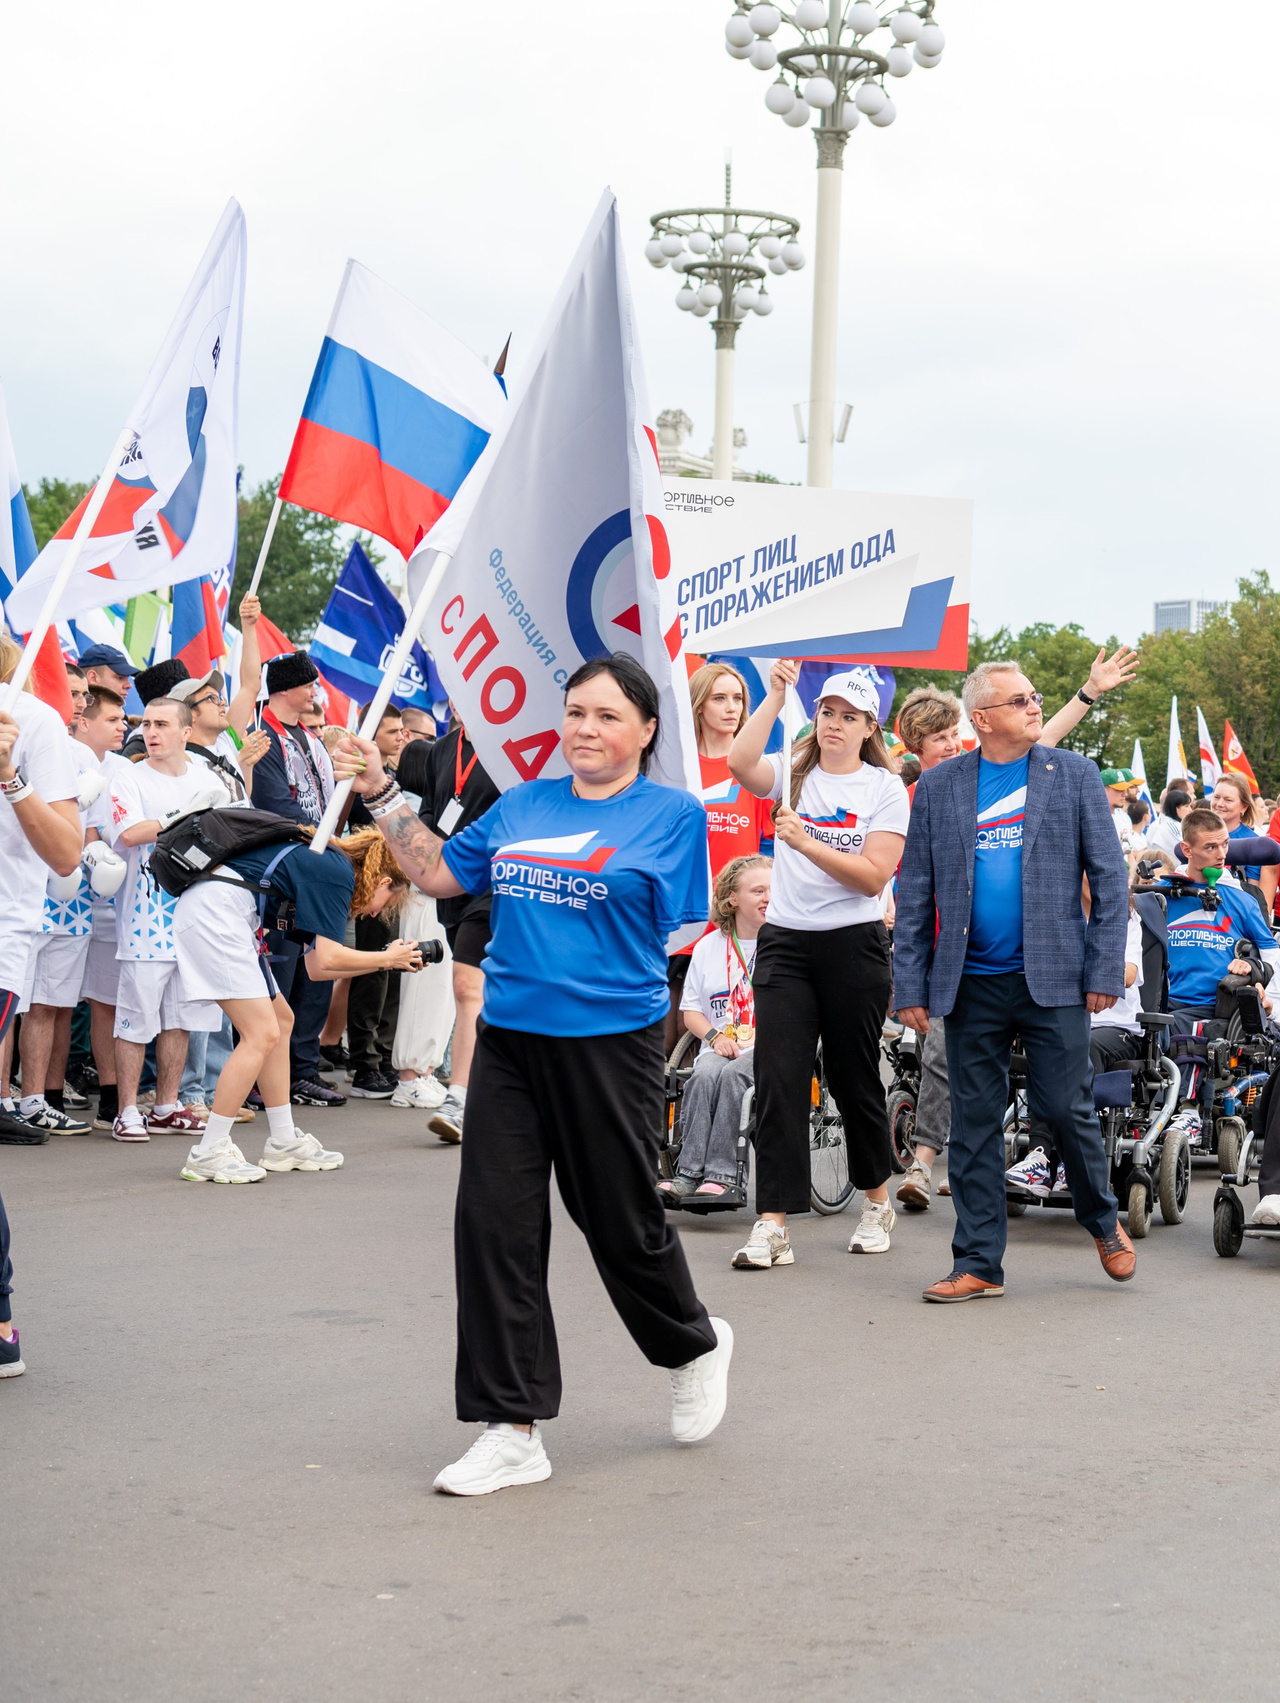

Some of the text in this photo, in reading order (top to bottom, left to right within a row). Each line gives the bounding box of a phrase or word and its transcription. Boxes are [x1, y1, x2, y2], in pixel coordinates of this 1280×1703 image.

[664, 491, 735, 507] ОРТИВНОЕ
[665, 504, 713, 514] СТВИЕ
[678, 534, 797, 607] СПОРТ ЛИЦ
[695, 548, 845, 634] ПОРАЖЕНИЕМ
[850, 528, 896, 570] ОДА
[489, 547, 557, 667] Федерация
[846, 680, 868, 699] RPC
[1170, 940, 1227, 951] ШЕСТВИЕ
